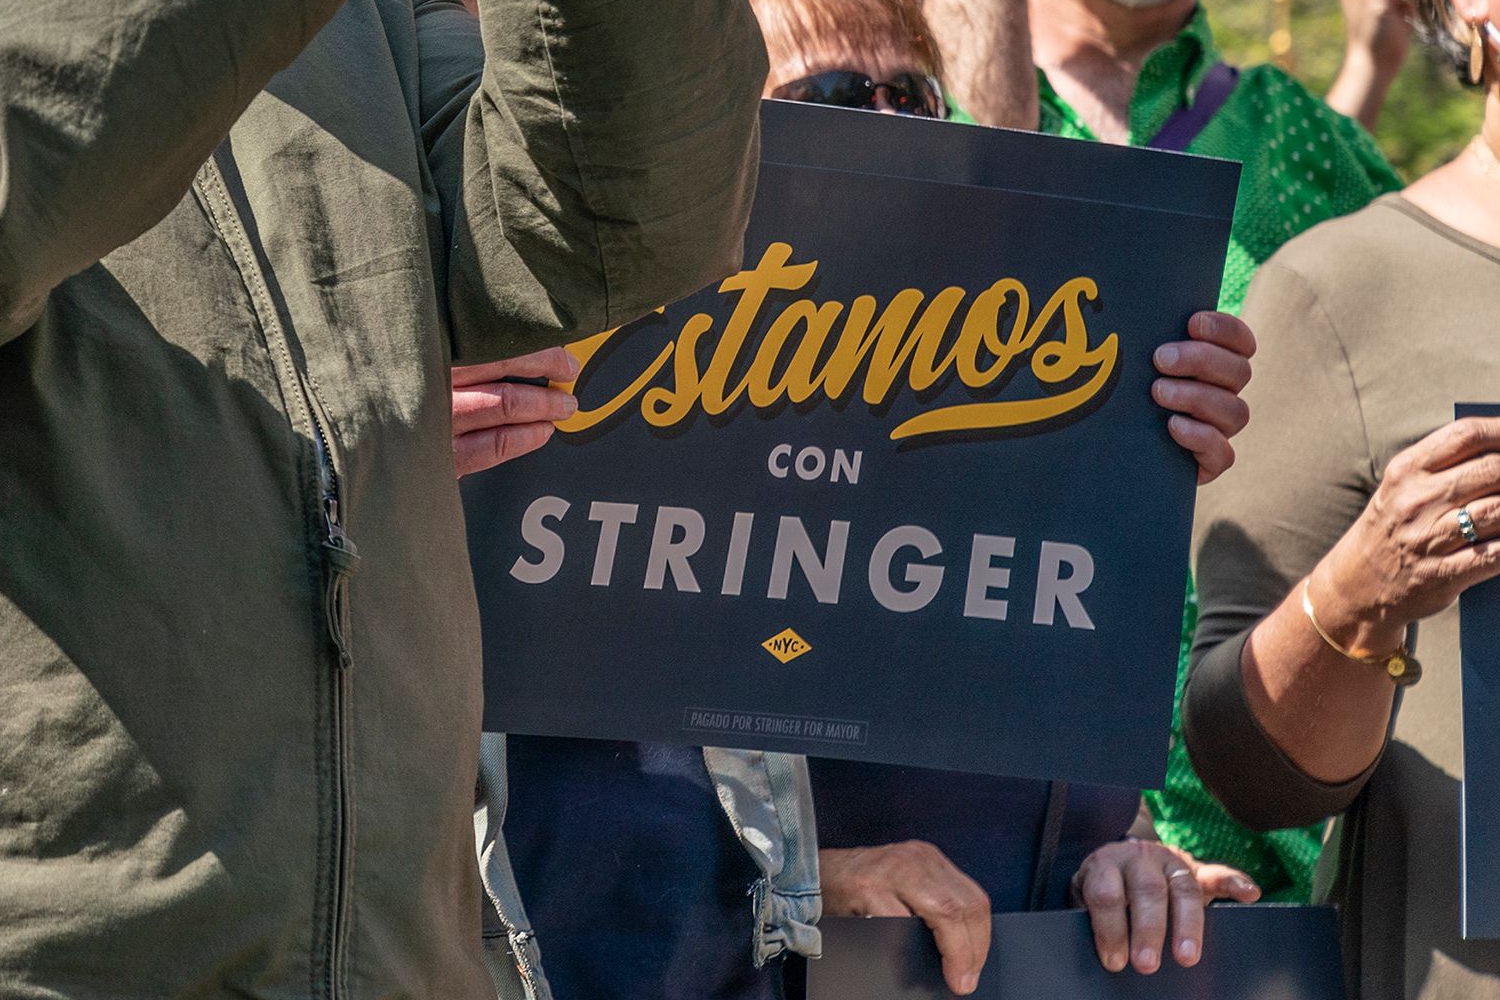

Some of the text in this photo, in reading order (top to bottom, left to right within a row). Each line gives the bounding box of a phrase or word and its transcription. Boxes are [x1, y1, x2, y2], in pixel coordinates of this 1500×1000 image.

[767, 443, 863, 484] CON
[509, 495, 1095, 631] STRINGER
[772, 637, 799, 654] NYC
[690, 712, 861, 741] PAGADO POR STRINGER FOR MAYOR
